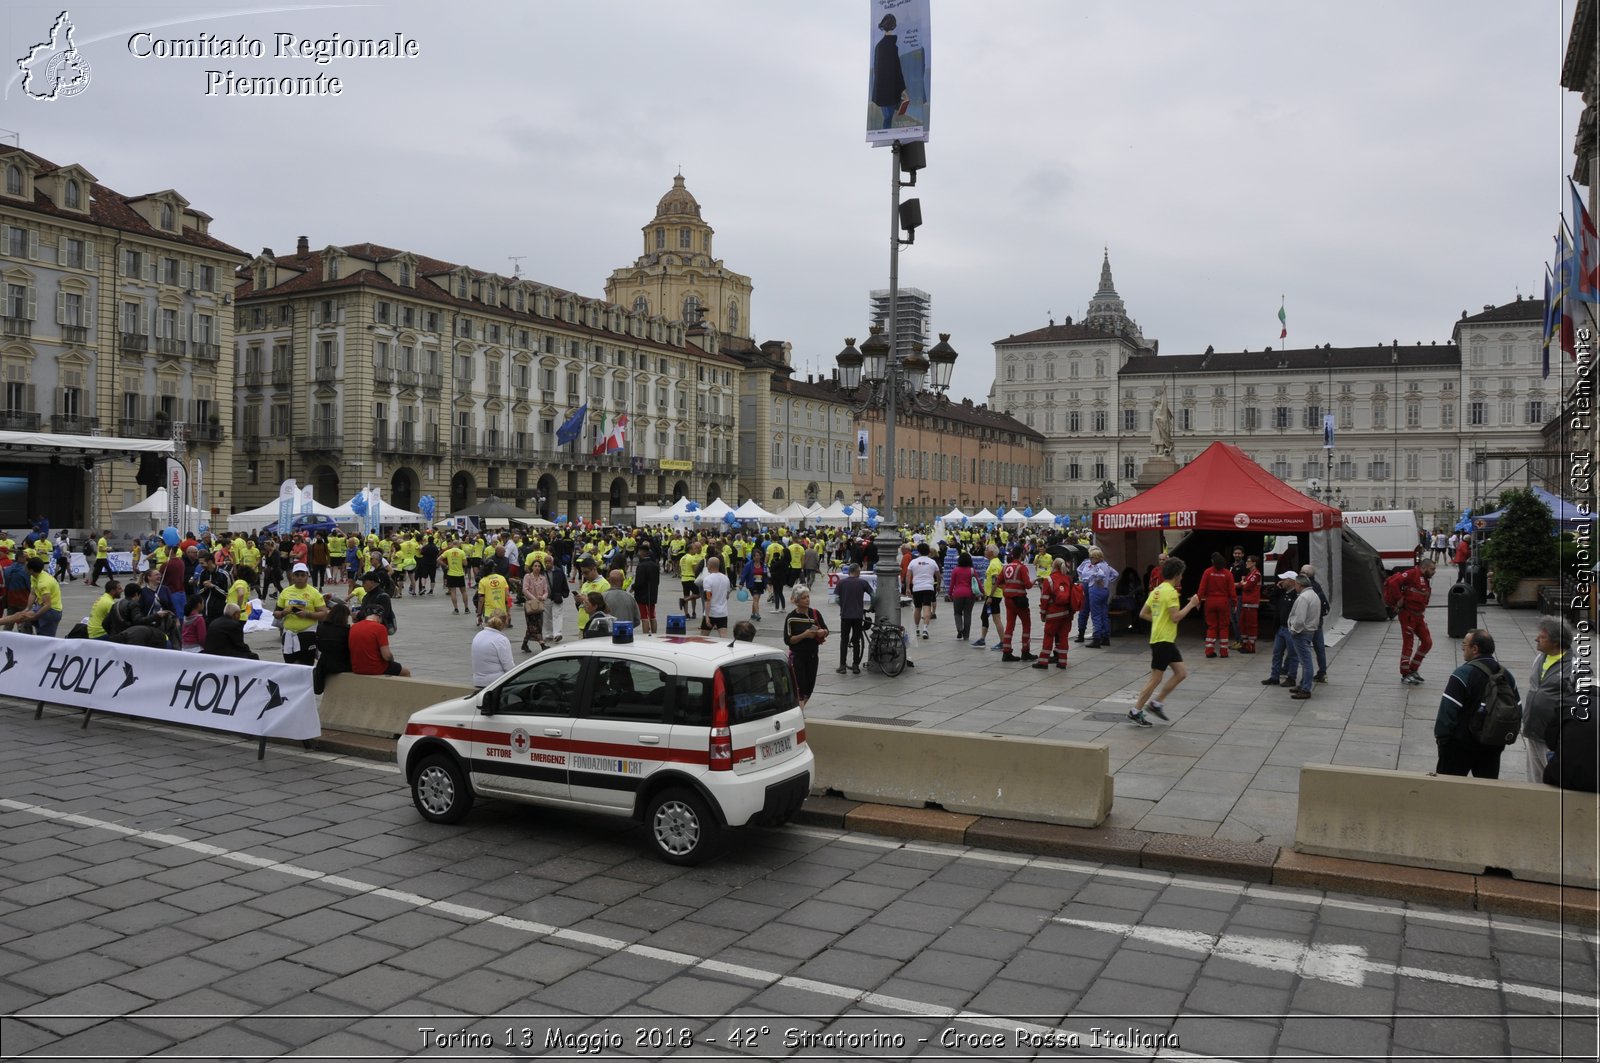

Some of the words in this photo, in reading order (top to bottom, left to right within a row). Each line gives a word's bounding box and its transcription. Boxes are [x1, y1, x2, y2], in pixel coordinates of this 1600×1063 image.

[1098, 513, 1162, 529] FONDAZIONE
[1177, 511, 1198, 526] CRT
[1351, 516, 1387, 525] ITALIANA
[38, 652, 115, 695] HOLY
[168, 669, 258, 716] HOLY
[486, 747, 512, 759] SETTORE
[530, 752, 565, 765] EMERGENZE
[573, 756, 617, 772] FONDAZIONE
[628, 761, 643, 775] CRT
